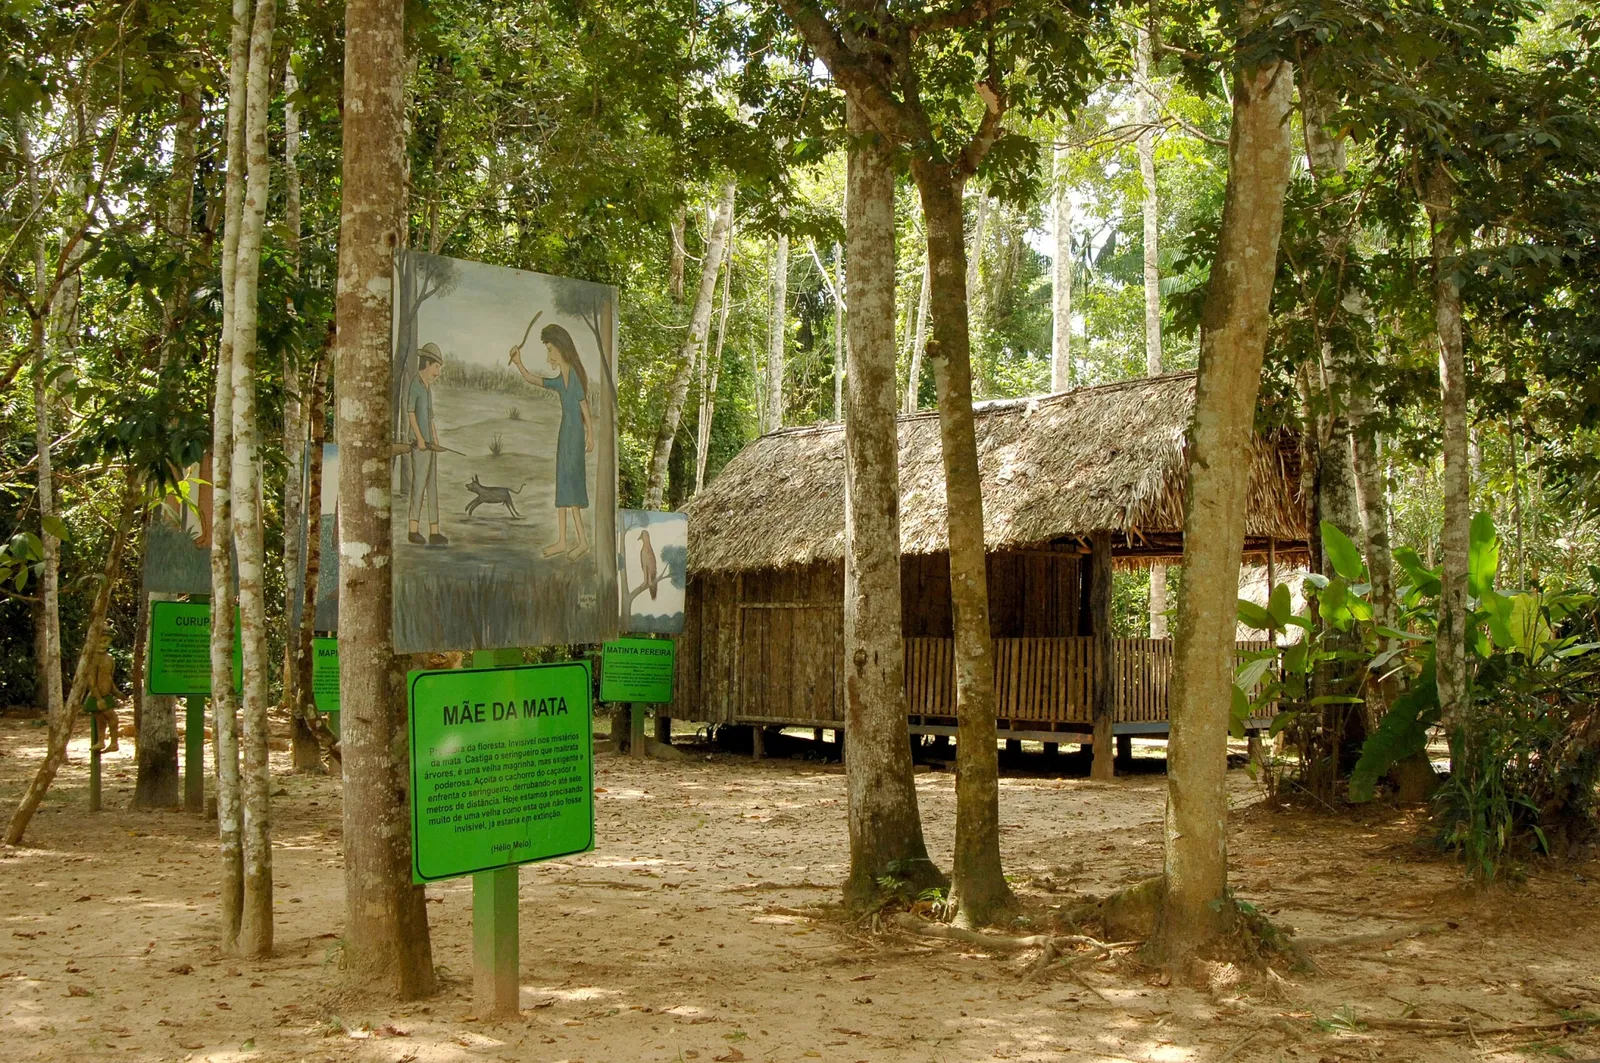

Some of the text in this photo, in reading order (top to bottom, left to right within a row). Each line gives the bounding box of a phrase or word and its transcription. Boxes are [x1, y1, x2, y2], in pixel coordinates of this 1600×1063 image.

[606, 646, 671, 656] MATINTA PEREIRA
[444, 696, 568, 726] MÃE DA MATA
[467, 744, 476, 752] da
[478, 742, 506, 750] floresta.
[551, 733, 579, 742] mistérios
[424, 771, 456, 780] árvores,
[482, 764, 501, 772] velha
[502, 760, 536, 770] magrinha,
[553, 754, 578, 764] exigente
[442, 757, 462, 766] mata.
[465, 754, 492, 764] Castiga
[501, 748, 539, 760] seringueiro
[541, 747, 552, 756] que
[554, 744, 578, 752] maltrata
[428, 791, 460, 802] enfrenta
[468, 786, 512, 797] seringueiro,
[512, 778, 556, 790] derrubando-o
[434, 779, 472, 792] poderosa.
[474, 776, 496, 786] Açoita
[505, 770, 536, 781] cachorro
[546, 766, 572, 776] caçador
[426, 785, 584, 814] metros de distância. Hoje estamos precisando
[428, 816, 450, 825] muito
[452, 813, 462, 821] de
[482, 808, 500, 817] velha
[502, 806, 521, 814] como
[523, 803, 537, 811] esta
[538, 801, 550, 810] que
[552, 798, 564, 806] não
[566, 796, 582, 804] fosse
[488, 820, 495, 830] já
[496, 817, 520, 826] estaria
[534, 810, 561, 820] extinção.
[491, 840, 532, 854] (Hélio Melo)
